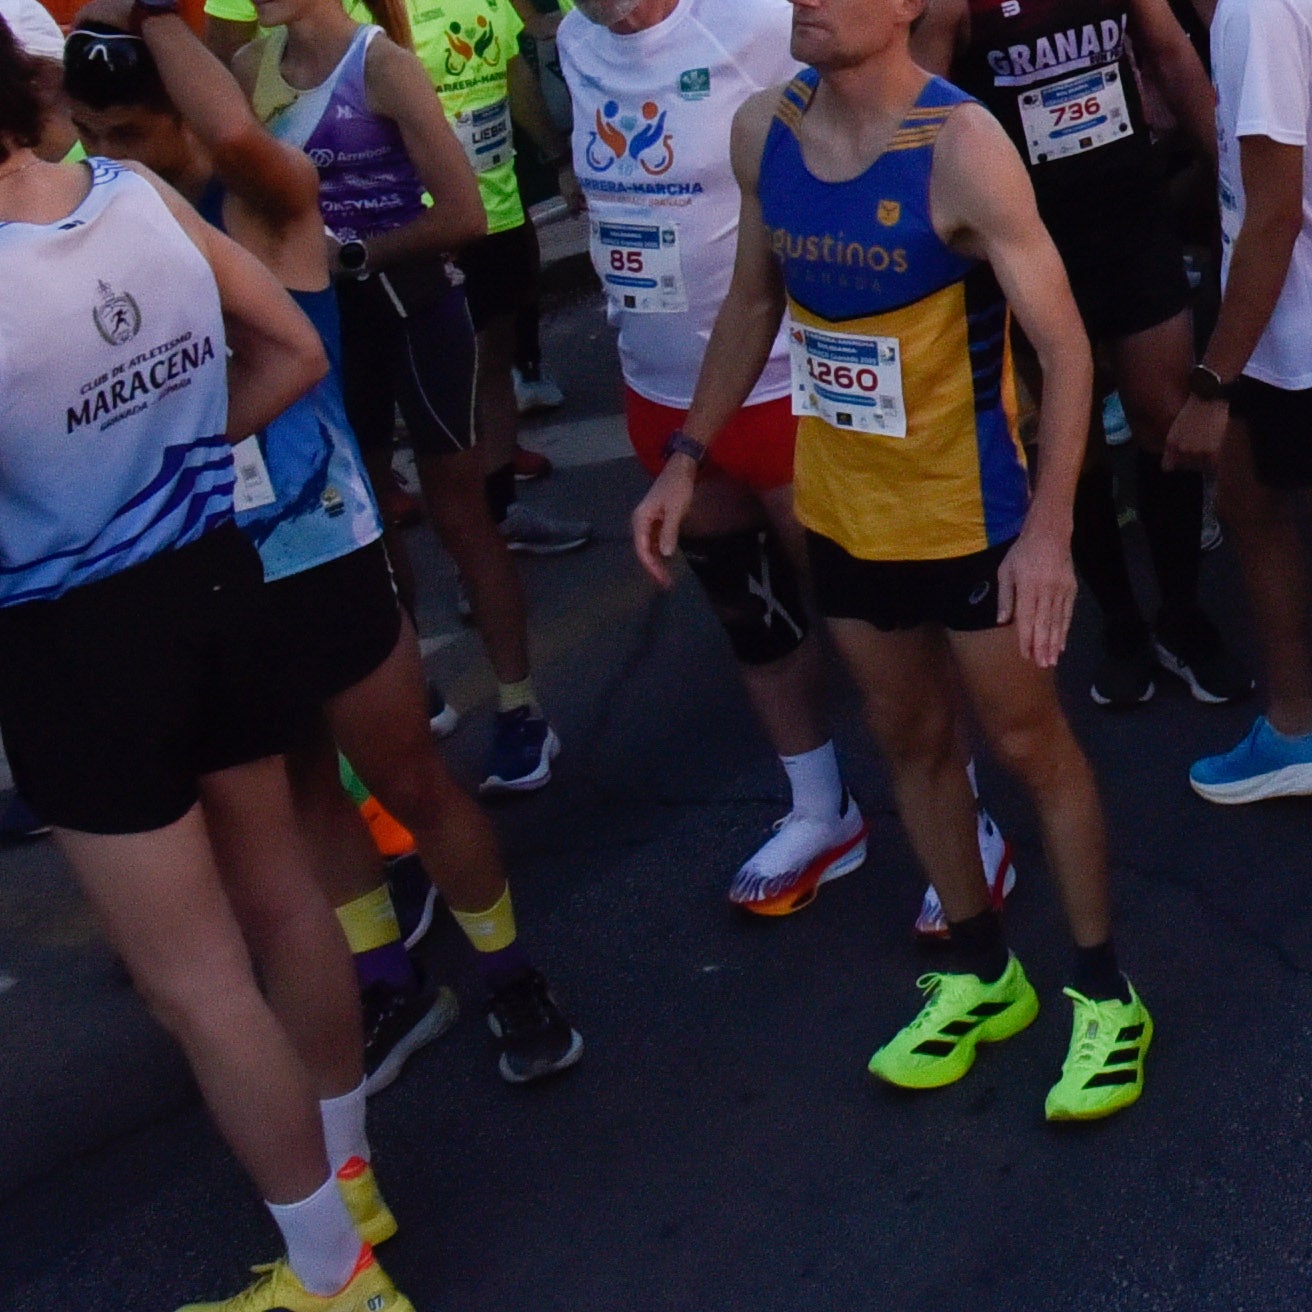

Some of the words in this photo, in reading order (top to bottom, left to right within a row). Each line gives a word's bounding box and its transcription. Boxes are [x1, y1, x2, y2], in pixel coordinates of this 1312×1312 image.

[986, 14, 1127, 76] GRANAD
[1049, 97, 1101, 127] 736
[610, 250, 644, 273] 85
[112, 364, 125, 378] DE
[128, 331, 193, 370] ATLETISMO
[806, 356, 879, 393] 1260
[67, 335, 216, 434] MARACENA
